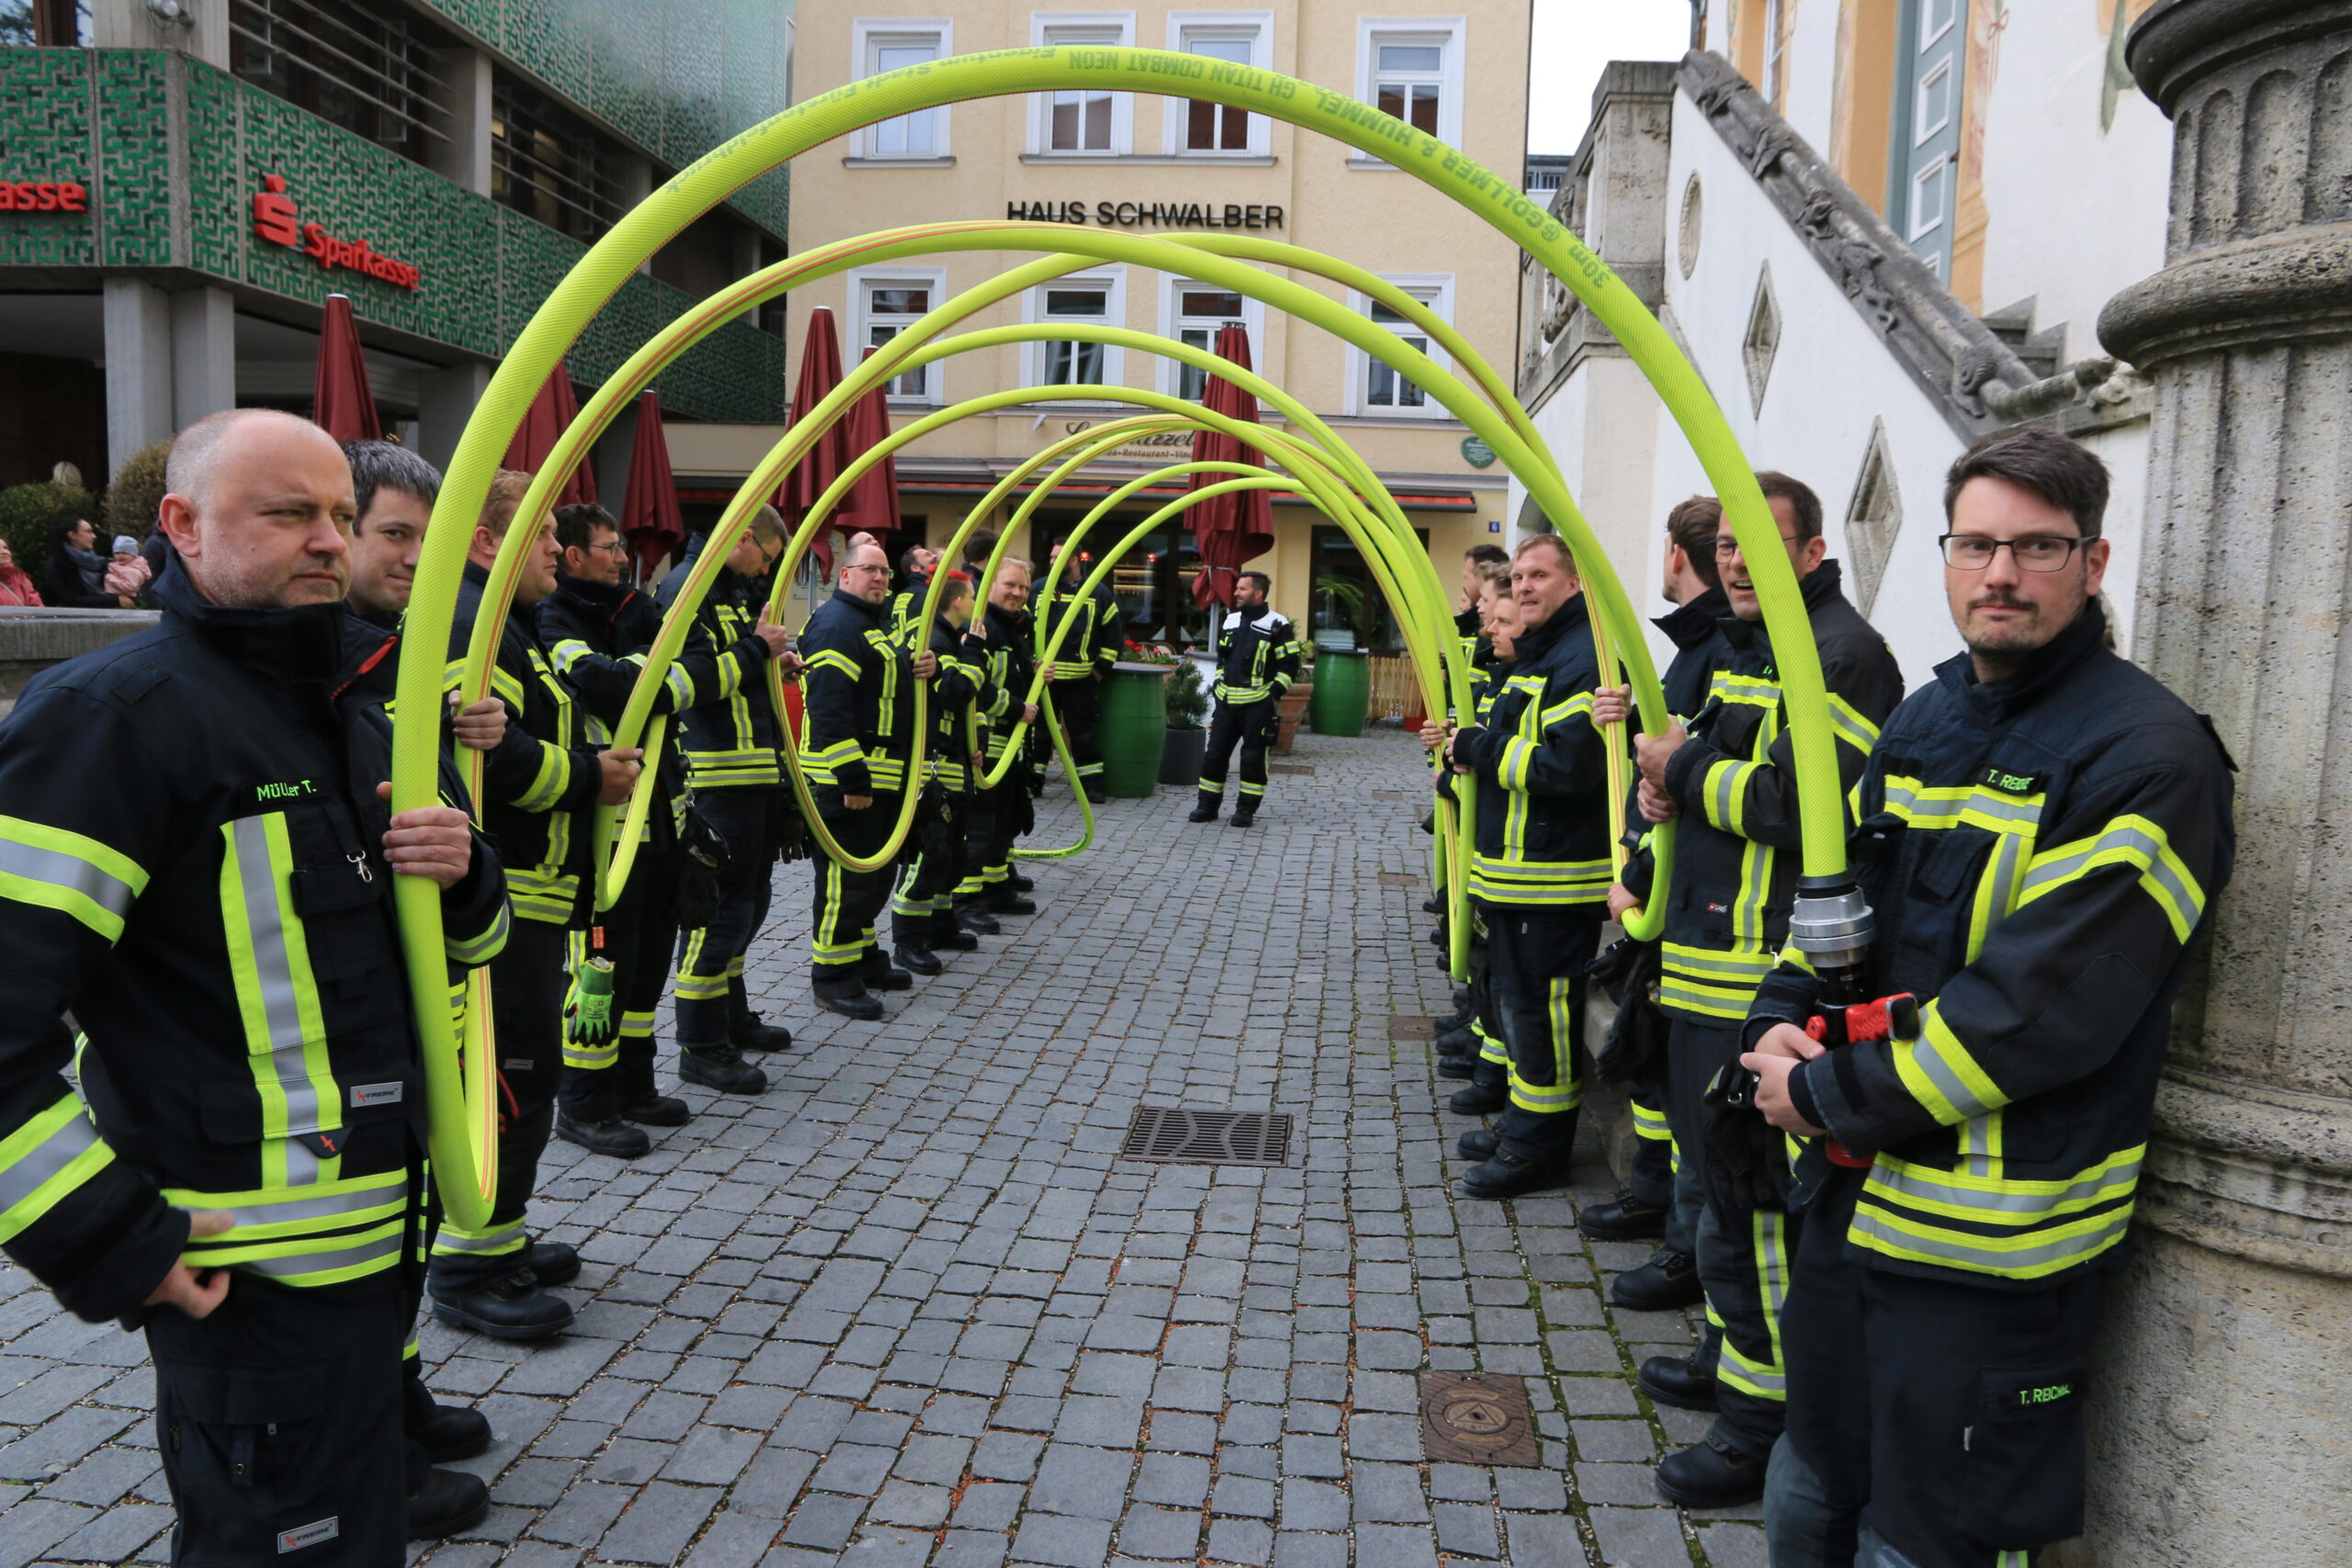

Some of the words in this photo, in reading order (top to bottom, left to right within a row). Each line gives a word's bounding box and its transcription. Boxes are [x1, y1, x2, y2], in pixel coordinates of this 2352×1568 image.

[1069, 51, 1119, 71] NEON
[1126, 52, 1204, 79] COMBAT
[1209, 63, 1263, 91] TITAN
[1269, 76, 1297, 100] GH
[1316, 87, 1419, 147] HUMMEL
[1421, 140, 1440, 159] &
[1442, 147, 1544, 229] GOLLMER
[1007, 200, 1086, 225] HAUS
[1096, 201, 1284, 230] SCHWALBER
[303, 222, 420, 291] Sparkasse
[1568, 243, 1611, 289] 30m
[256, 782, 300, 802] Müller
[300, 779, 317, 794] T.
